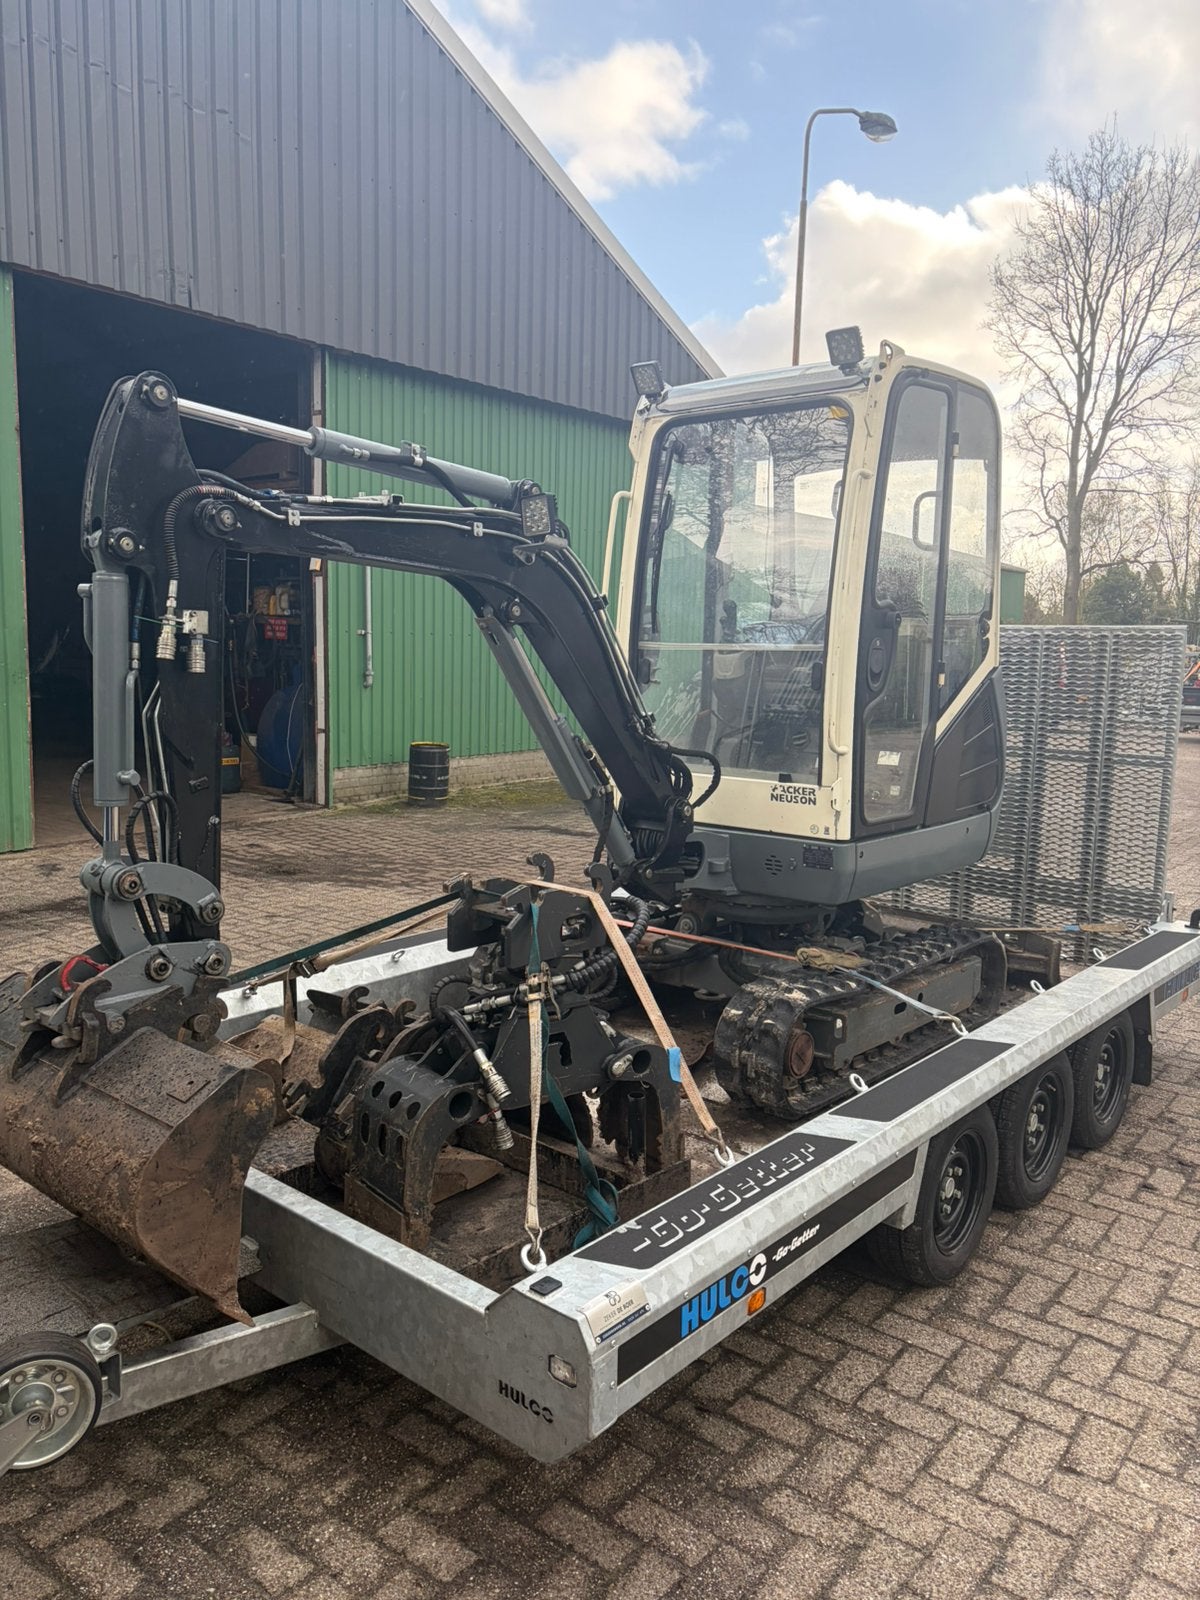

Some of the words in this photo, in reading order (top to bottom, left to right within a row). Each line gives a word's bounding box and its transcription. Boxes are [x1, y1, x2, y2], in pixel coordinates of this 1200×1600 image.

[770, 793, 816, 806] NEUSON
[680, 1252, 767, 1339] HULCO
[498, 1379, 554, 1424] HULCO
